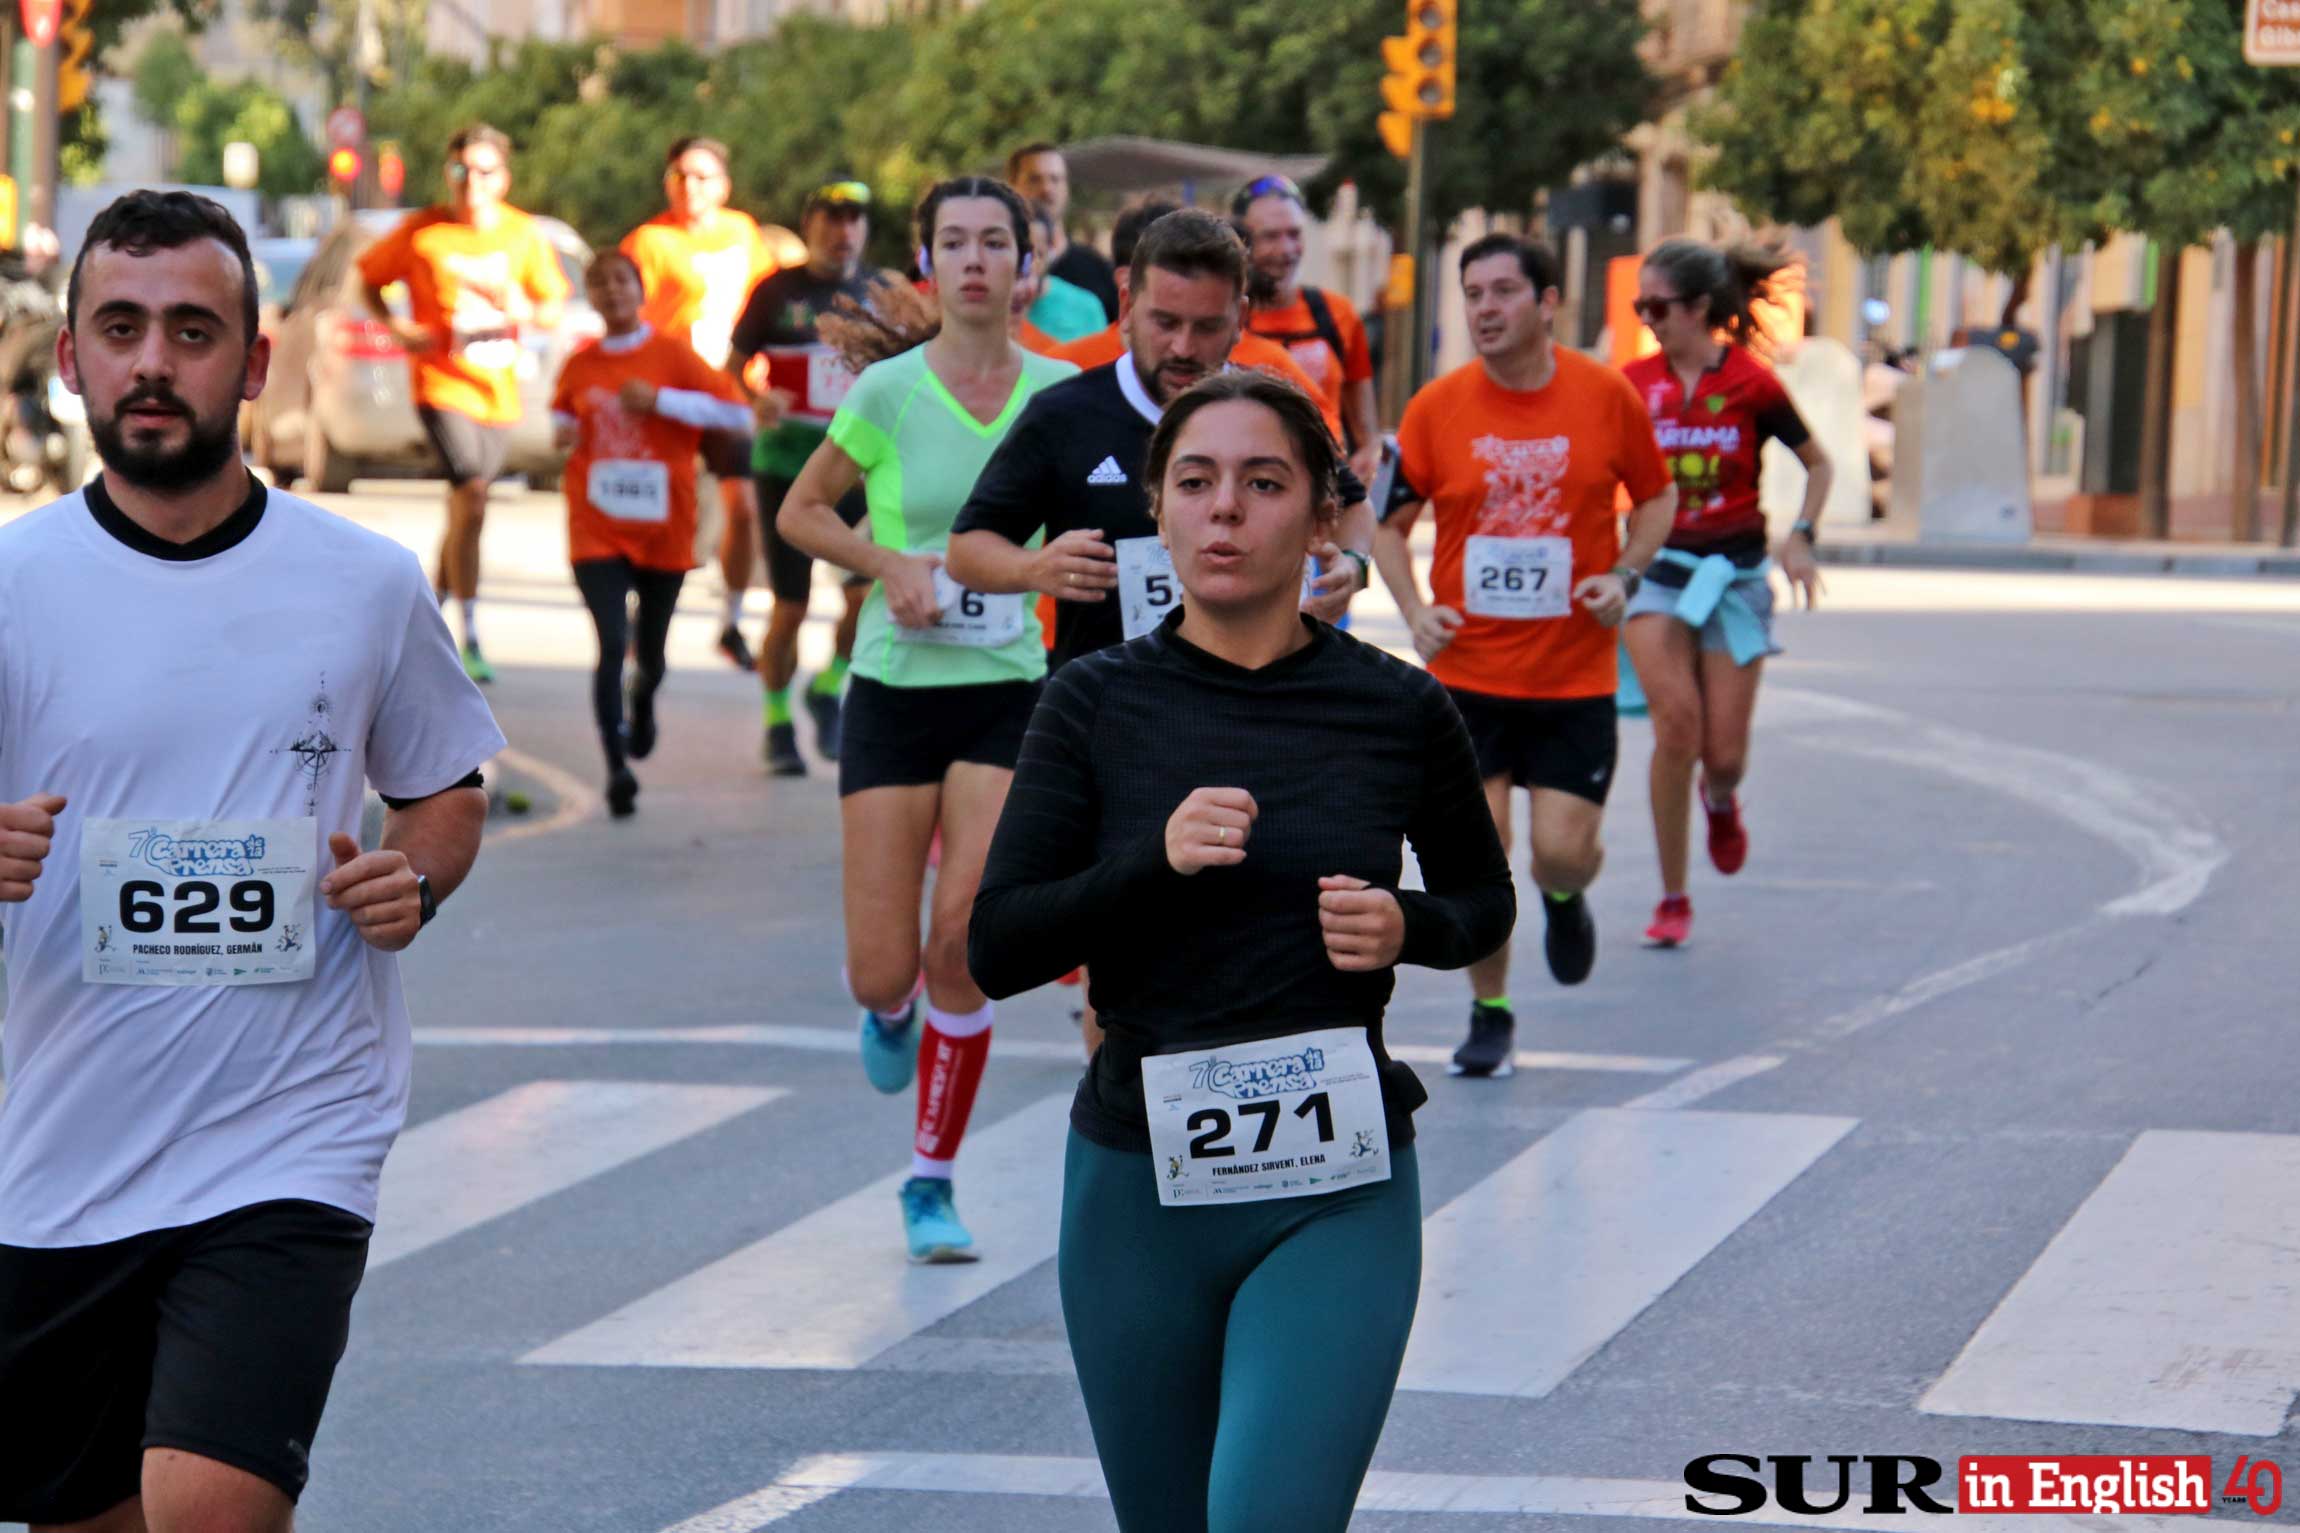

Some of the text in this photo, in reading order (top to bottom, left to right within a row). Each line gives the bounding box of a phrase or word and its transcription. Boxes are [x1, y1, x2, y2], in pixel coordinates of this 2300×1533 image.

[1087, 473, 1128, 485] adidas
[1145, 574, 1183, 607] 5
[1481, 566, 1549, 592] 267
[148, 836, 247, 861] Carrera
[168, 857, 252, 876] Prensa
[119, 880, 275, 933] 629
[132, 941, 263, 956] PACHECO RODRÍGUEZ, GERMÁN
[1211, 1054, 1306, 1088] Carrera
[1231, 1071, 1317, 1098] Prensa
[1186, 1091, 1335, 1159] 271
[1212, 1163, 1259, 1176] FERNÁNDEZ
[1300, 1154, 1326, 1167] ELENA
